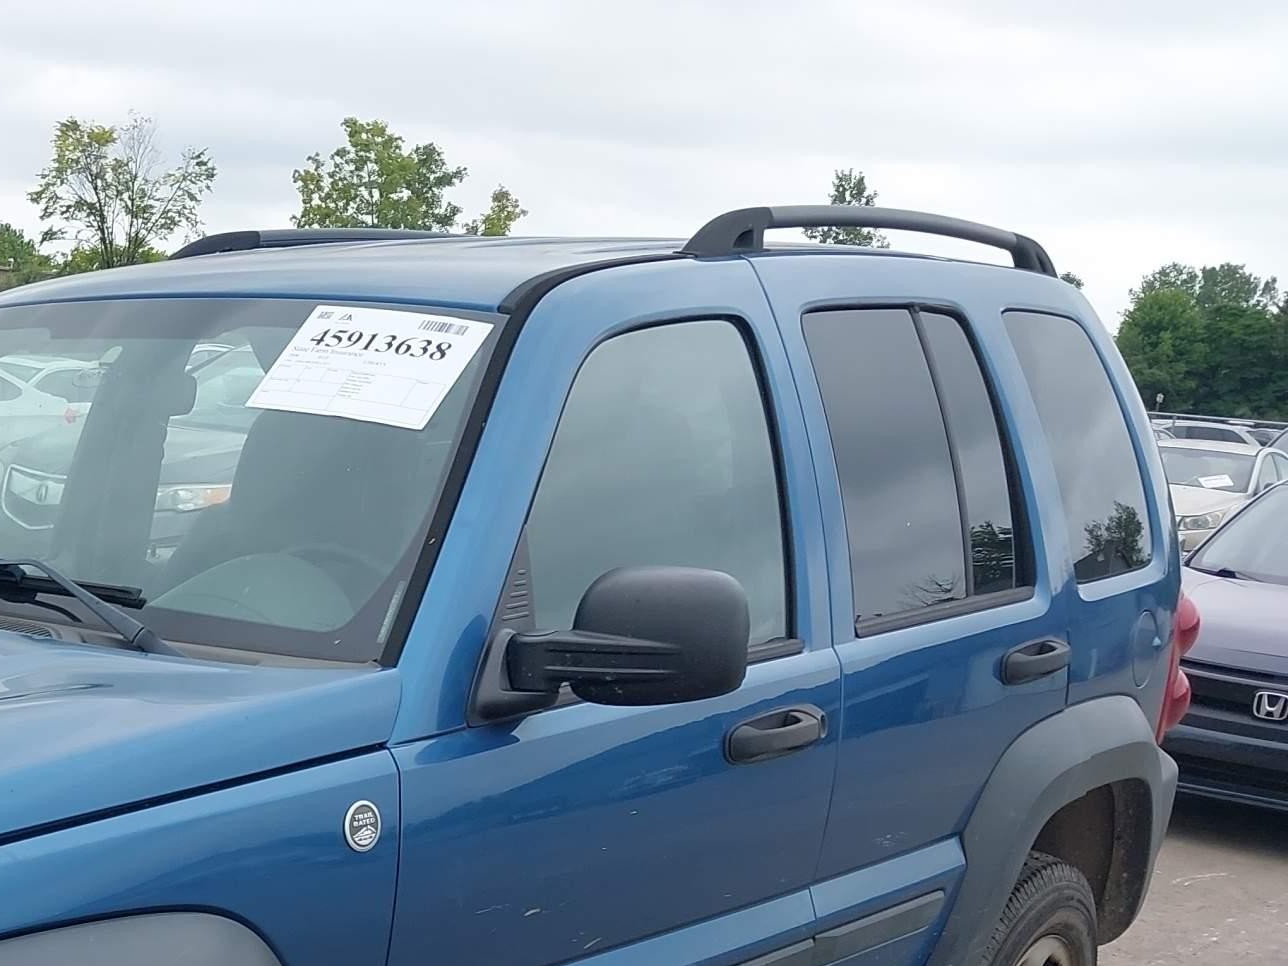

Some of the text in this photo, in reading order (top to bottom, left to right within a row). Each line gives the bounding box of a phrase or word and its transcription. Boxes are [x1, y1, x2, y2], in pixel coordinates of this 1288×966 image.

[310, 328, 452, 360] 45913638
[354, 812, 373, 821] TRAIL
[353, 818, 376, 827] RATED
